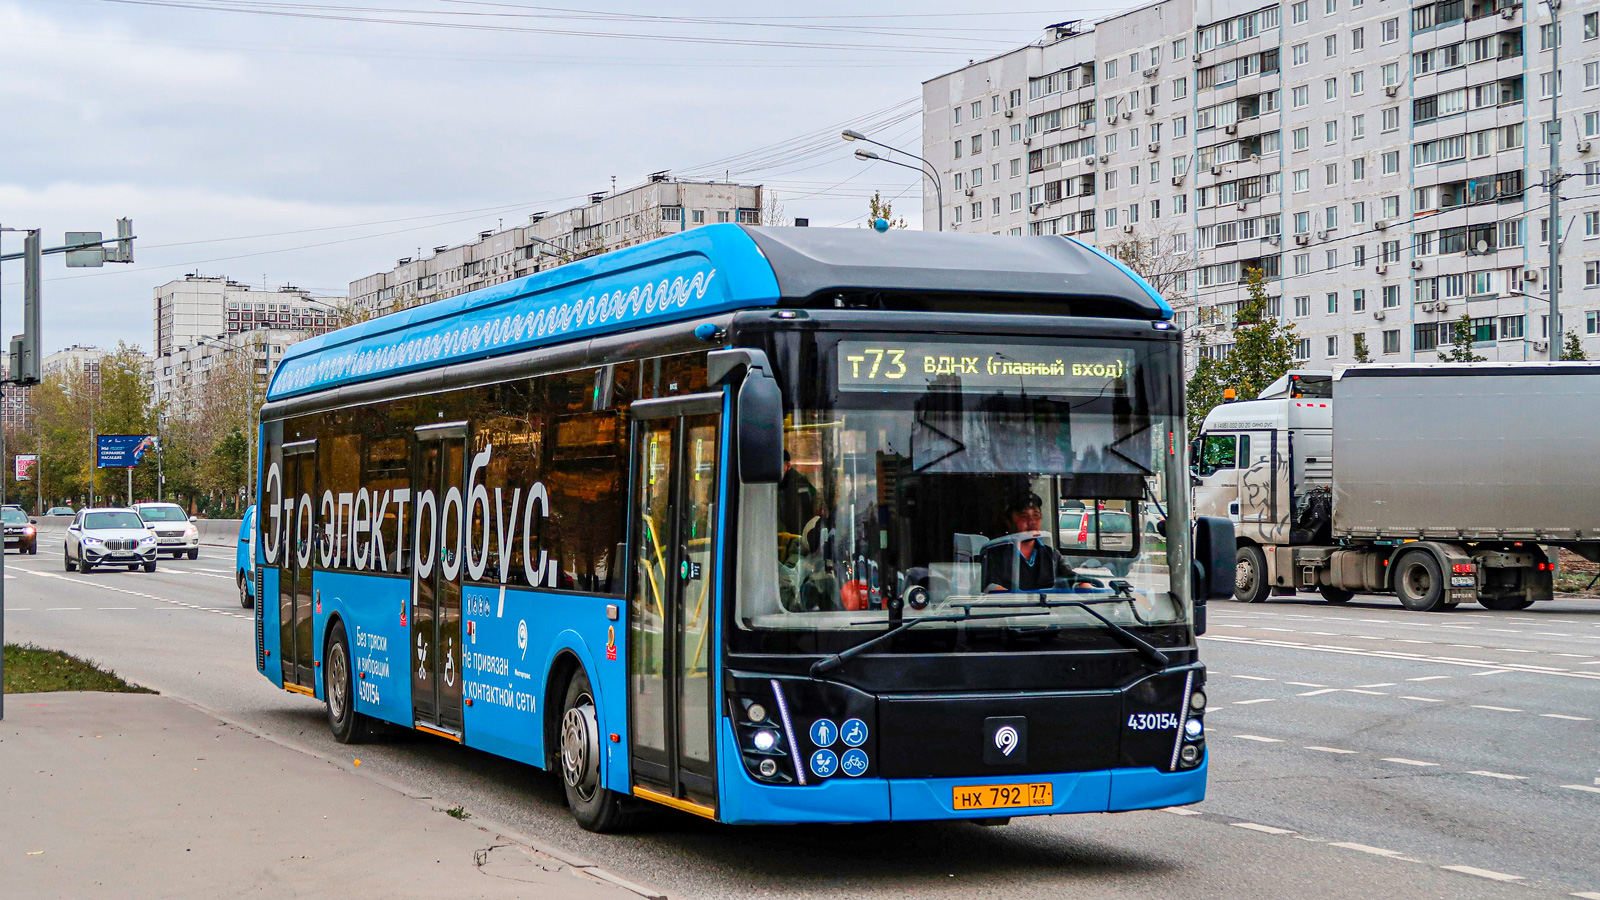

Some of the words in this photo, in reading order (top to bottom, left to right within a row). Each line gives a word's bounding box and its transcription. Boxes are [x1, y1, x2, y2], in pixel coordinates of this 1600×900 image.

[847, 349, 907, 379] т73
[924, 356, 979, 375] ВДНХ
[986, 356, 1065, 376] (главный
[1072, 359, 1123, 378] вход)
[264, 462, 313, 569] Это
[320, 443, 558, 618] электробус.
[356, 625, 367, 648] Без
[367, 633, 388, 654] тряски
[357, 656, 361, 671] и
[361, 653, 390, 679] вибраций
[462, 643, 472, 669] Не
[473, 652, 509, 677] привязан
[358, 680, 380, 706] 430154
[462, 679, 467, 697] к
[468, 682, 514, 708] контактной
[515, 691, 536, 714] сети
[1127, 713, 1178, 730] 430154
[989, 787, 1021, 806] 792
[1030, 785, 1047, 799] 77
